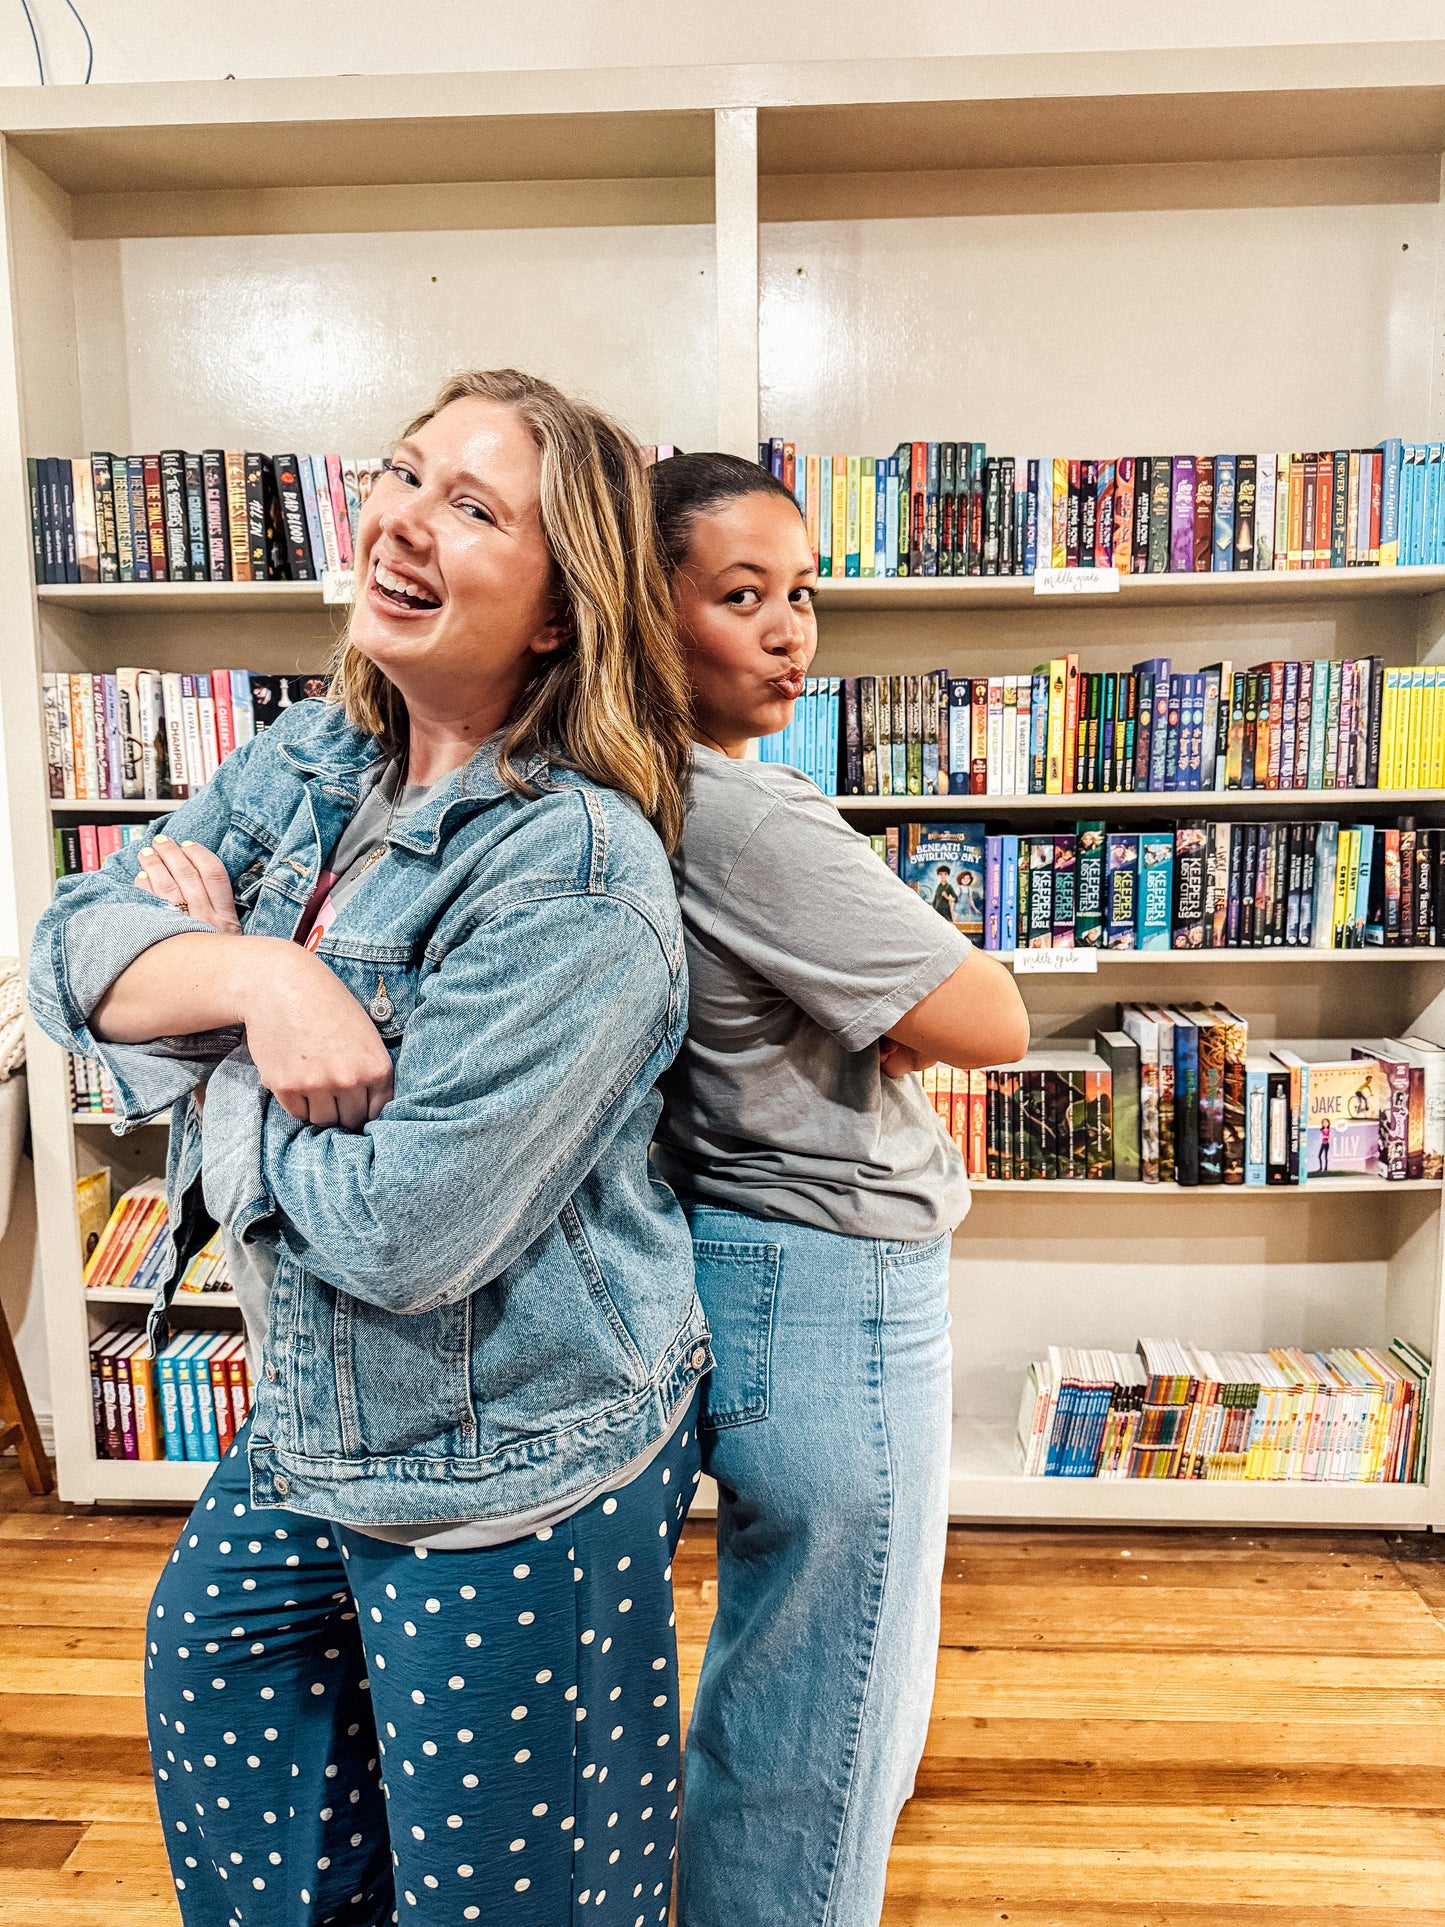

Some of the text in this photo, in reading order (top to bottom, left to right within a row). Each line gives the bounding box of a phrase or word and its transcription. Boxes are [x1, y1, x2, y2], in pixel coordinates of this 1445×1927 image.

[104, 504, 114, 519] SAME
[282, 492, 304, 543] BAD BLOOD
[1336, 461, 1345, 524] NEVER AFTER
[1387, 494, 1396, 537] Nightingale
[114, 475, 133, 568] THE INHERITANCE GAMES
[131, 475, 148, 563] THE HAWTHORNE LEGACY
[147, 484, 164, 557] THE FINAL GAMBIT
[190, 496, 204, 565] GRANDEST GAME
[207, 489, 224, 570] GLORIOUS RIVALS
[229, 480, 249, 563] GAMES UNTOLD
[250, 520, 263, 537] IN
[1027, 492, 1036, 549] ARTEMIS FOWL
[1070, 495, 1079, 548] ARTEMIS FOWL
[1086, 495, 1096, 549] ARTEMIS FOWL
[1103, 496, 1112, 548] ARTEMIS FOWL
[1140, 492, 1149, 546] ARTEMIS FOWL
[187, 711, 196, 739] RIVALS
[203, 710, 211, 735] REIGN
[219, 708, 229, 747] QUEEN'S
[1052, 698, 1062, 754] spy school
[1068, 686, 1076, 729] spy school
[170, 721, 183, 779] CHAMPION
[954, 710, 966, 769] DRAGON RIDER
[910, 851, 959, 864] SWIRLING
[961, 852, 982, 864] SKY
[916, 842, 961, 853] BENEATH
[1216, 851, 1226, 872] WOLF
[1360, 862, 1369, 877] LU
[1032, 870, 1041, 920] LOST CITIES
[1039, 870, 1051, 918] KEEPER
[1055, 872, 1064, 920] LOST CITIES
[1063, 872, 1074, 918] KEEPER
[1079, 858, 1090, 911] LOST CITIES
[1088, 858, 1100, 909] KEEPER
[1113, 871, 1122, 921] LOST CITIES
[1121, 870, 1133, 920] KEEPER
[1146, 870, 1156, 921] LOST CITIES
[1155, 870, 1167, 920] KEEPER
[1180, 858, 1190, 911] LOST CITIES
[1189, 858, 1201, 910] KEEPER
[1215, 888, 1225, 911] FIRE
[1338, 866, 1346, 897] GHOST
[1401, 851, 1413, 921] STORY THIEVES
[1419, 863, 1429, 925] STORY THIEVES
[1388, 893, 1396, 925] THIEVES
[1311, 1095, 1342, 1114] JAKE
[1333, 1136, 1360, 1157] LILY
